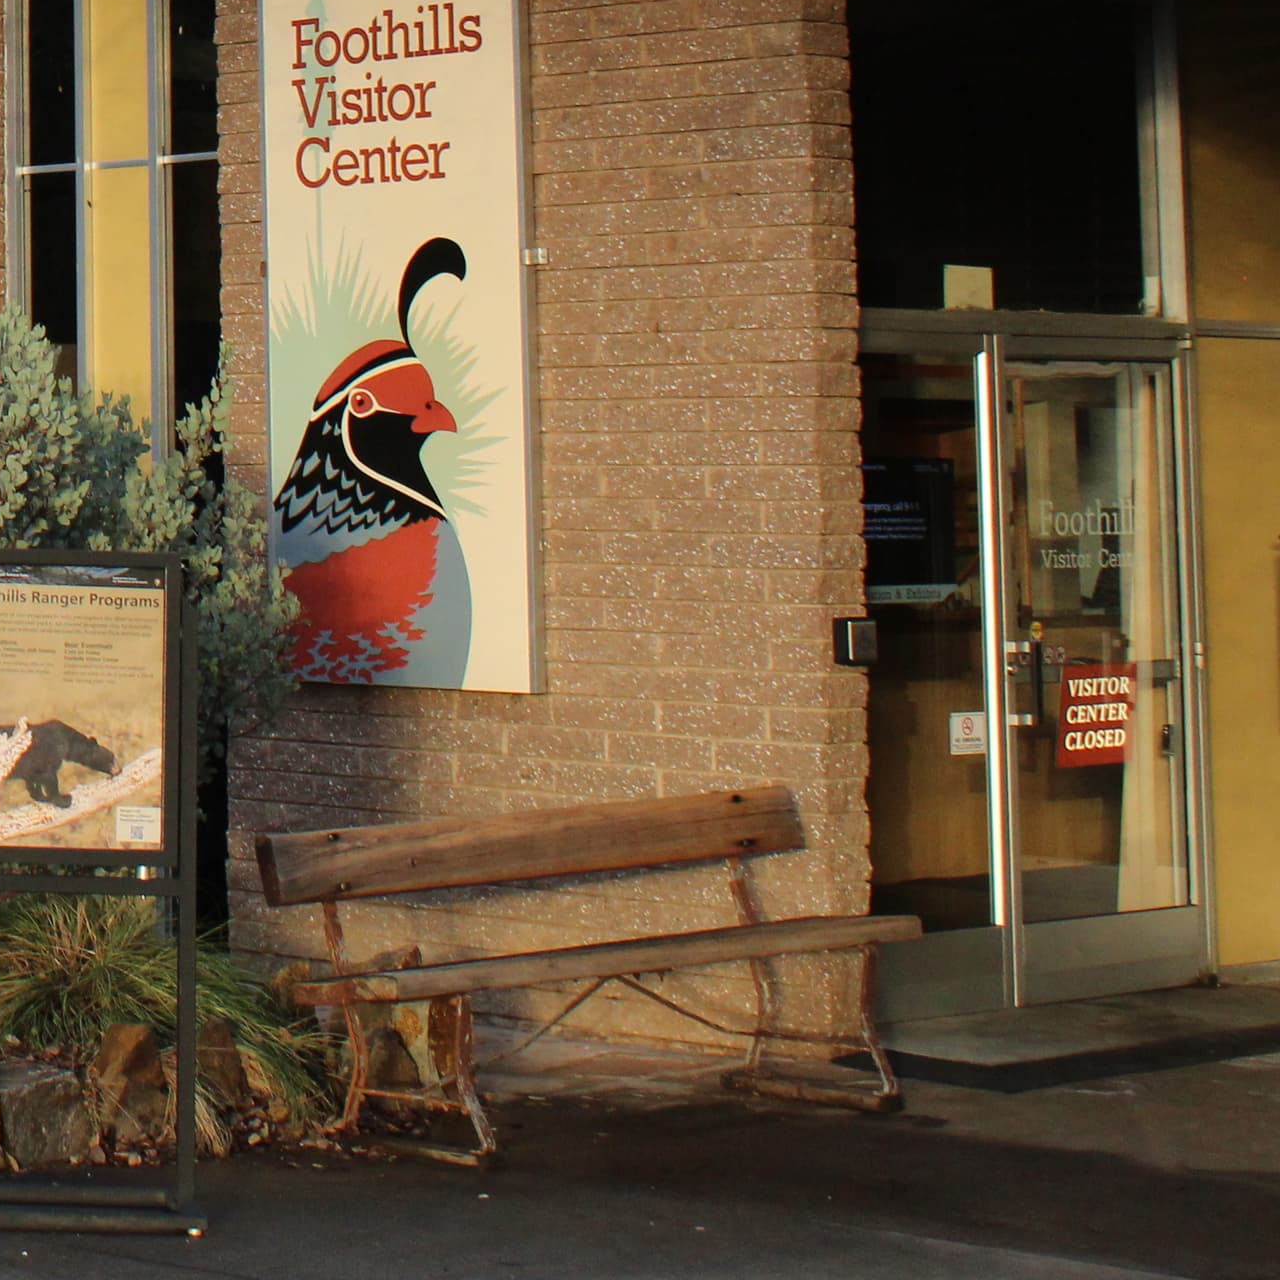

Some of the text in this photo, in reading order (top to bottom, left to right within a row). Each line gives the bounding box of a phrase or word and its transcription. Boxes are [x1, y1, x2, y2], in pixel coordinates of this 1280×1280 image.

[291, 2, 482, 69] Foothills
[291, 72, 436, 128] Visitor
[295, 136, 451, 189] Center
[1038, 498, 1136, 537] Foothill
[1040, 547, 1133, 569] Visitor Cent
[31, 592, 85, 608] Ranger
[89, 593, 160, 609] Programs
[1068, 676, 1130, 697] VISITOR
[1066, 703, 1128, 724] CENTER
[1065, 729, 1127, 750] CLOSED
